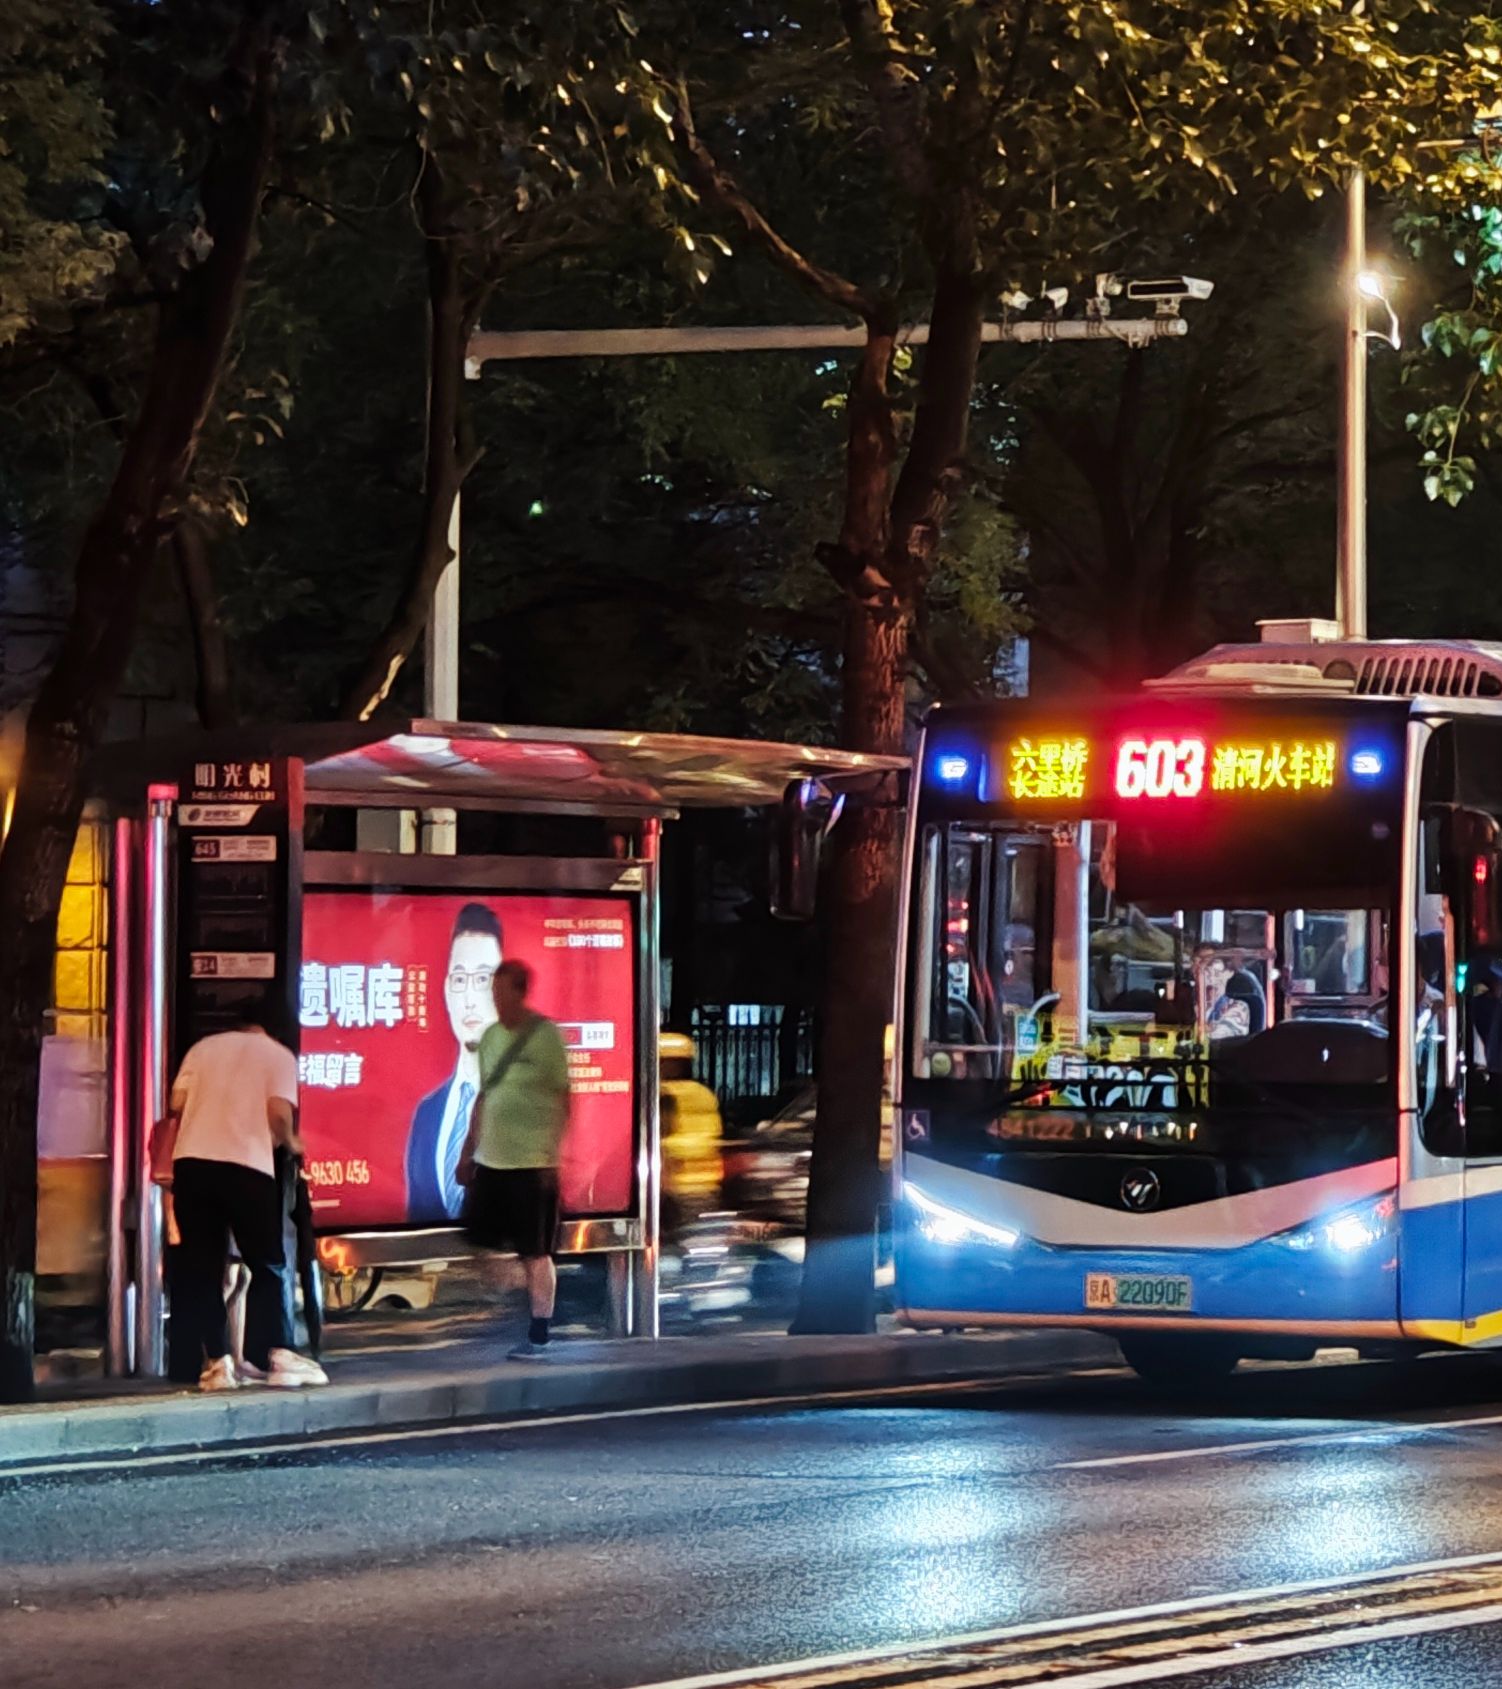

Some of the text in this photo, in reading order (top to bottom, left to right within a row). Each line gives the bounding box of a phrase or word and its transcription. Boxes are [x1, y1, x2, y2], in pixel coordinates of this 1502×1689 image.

[195, 763, 271, 788] 明光村
[1116, 739, 1206, 798] 603
[1211, 742, 1336, 791] 清河火车站
[346, 1158, 370, 1185] 456
